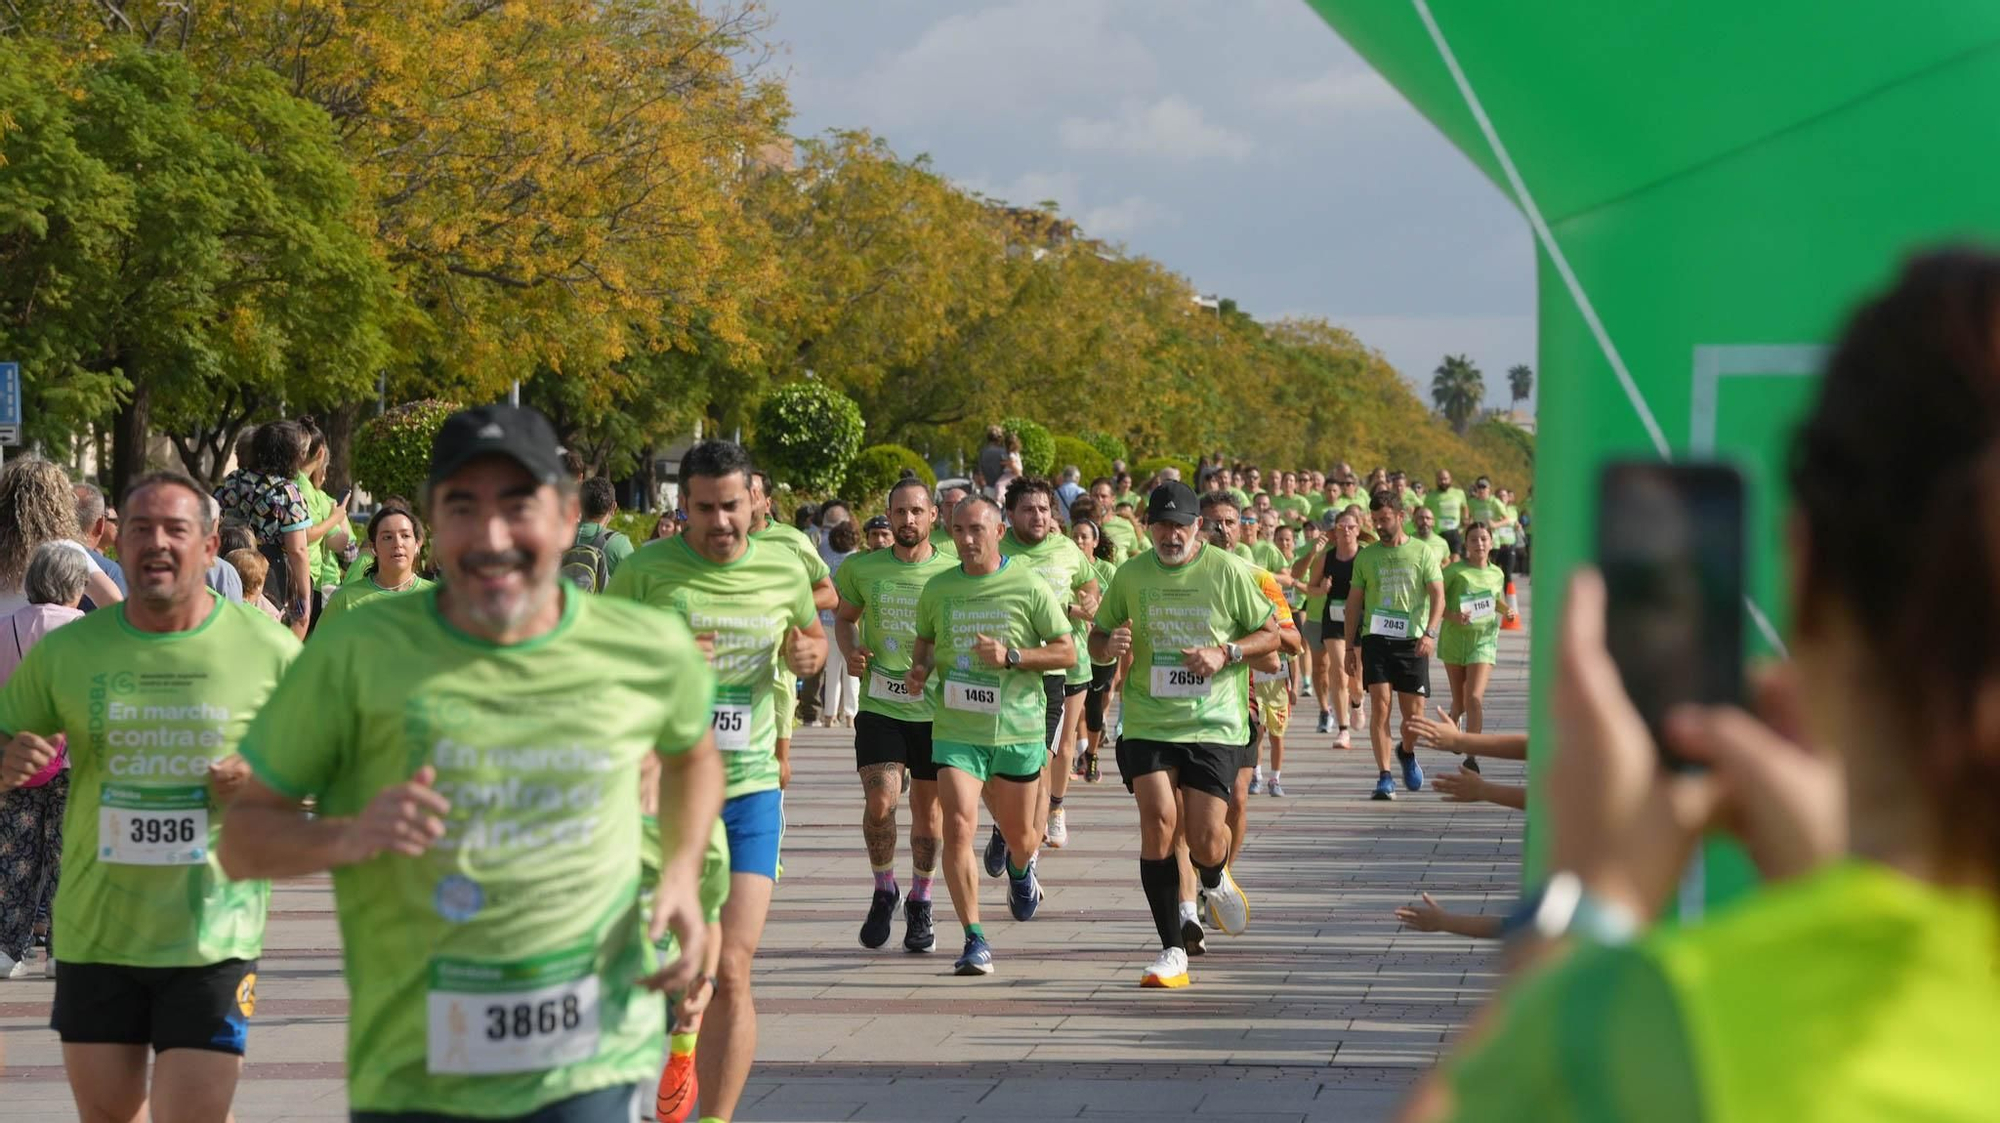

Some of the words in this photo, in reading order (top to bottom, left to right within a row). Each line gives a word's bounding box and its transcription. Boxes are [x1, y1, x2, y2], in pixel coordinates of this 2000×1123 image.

[953, 609, 966, 619] En
[1149, 605, 1162, 616] En
[690, 612, 712, 628] En
[1383, 619, 1406, 631] 2043
[964, 688, 995, 704] 1463
[108, 702, 137, 720] En
[143, 702, 230, 720] marcha
[108, 726, 196, 747] contra
[199, 726, 224, 747] el
[436, 738, 478, 768] En
[486, 742, 612, 772] marcha
[130, 818, 195, 844] 3936
[486, 994, 579, 1040] 3868
